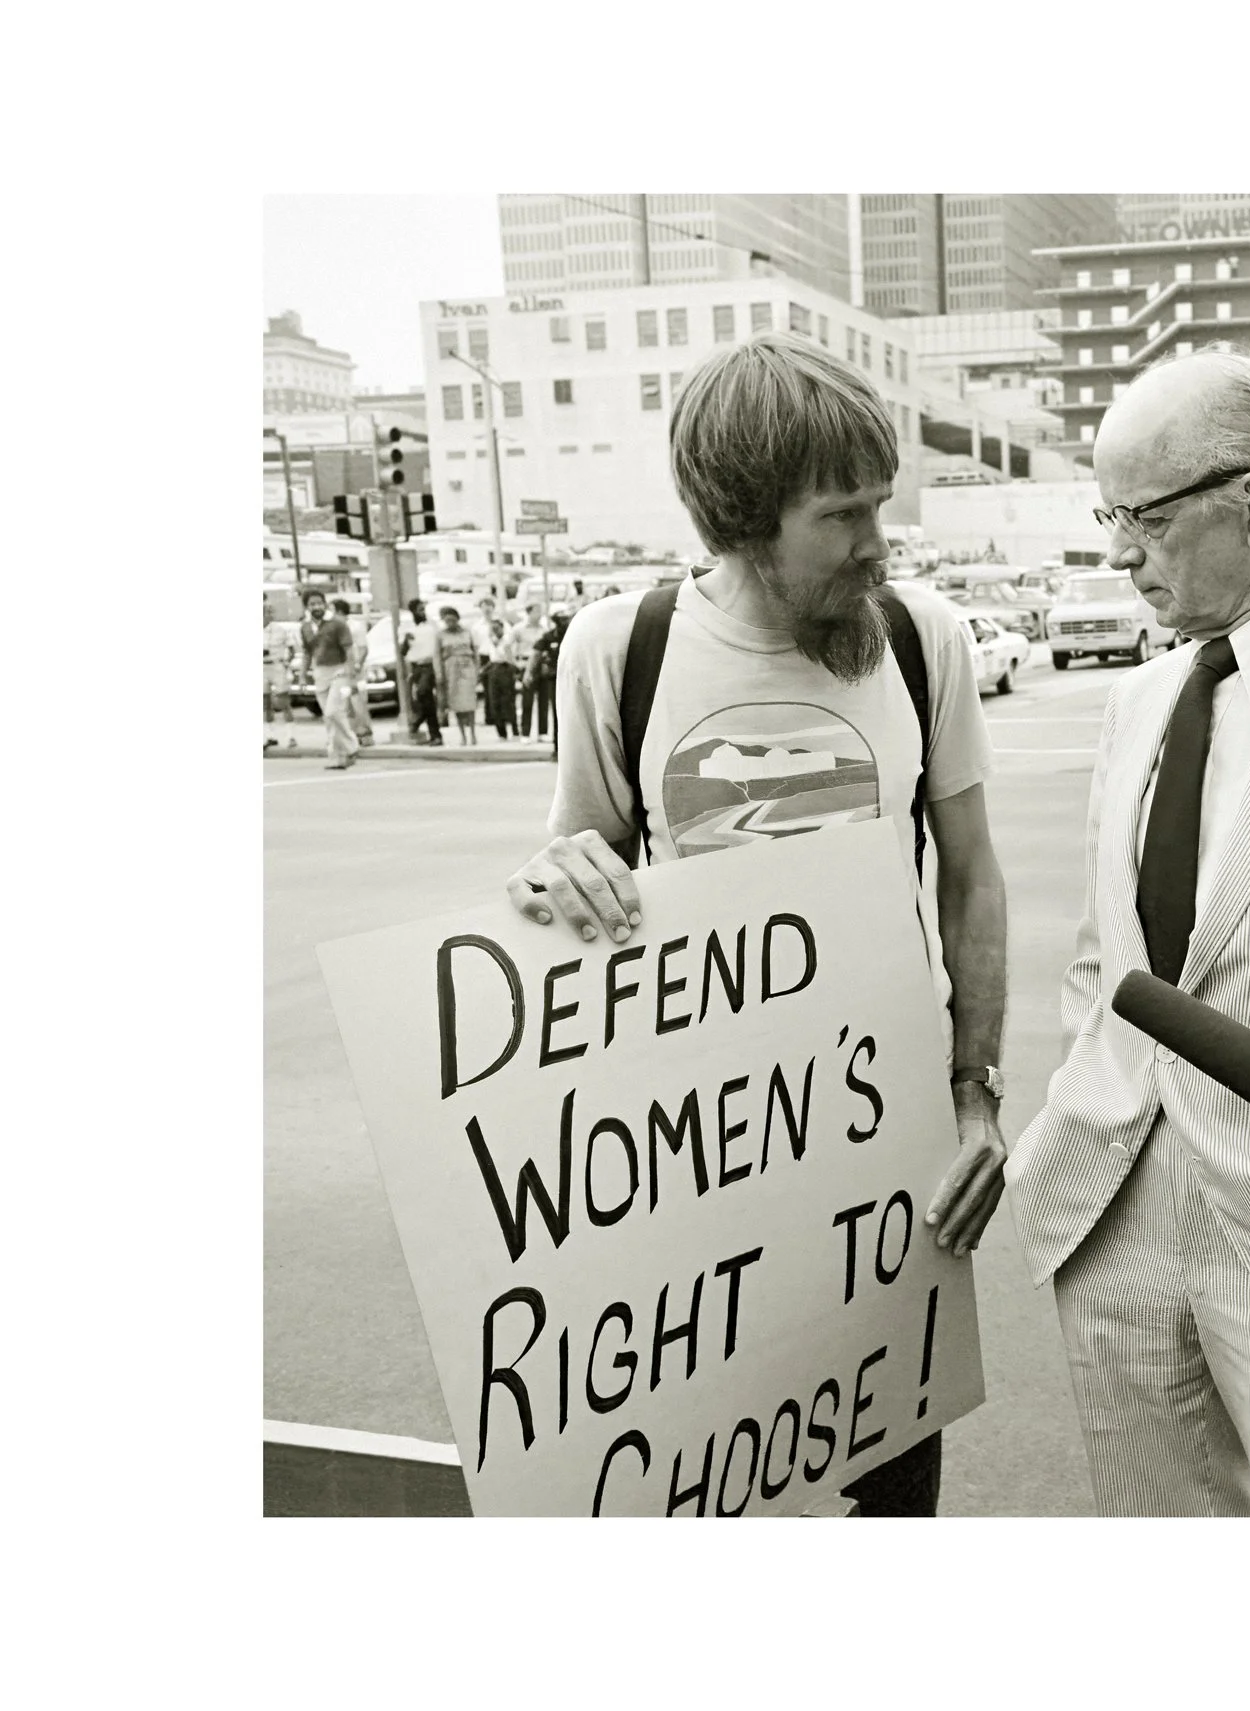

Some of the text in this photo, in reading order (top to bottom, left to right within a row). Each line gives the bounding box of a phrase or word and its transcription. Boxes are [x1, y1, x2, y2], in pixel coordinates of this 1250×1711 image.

[438, 913, 817, 1099] DEFEND
[466, 1025, 884, 1263] WOMEN'S
[477, 1190, 914, 1473] RIGHT TO
